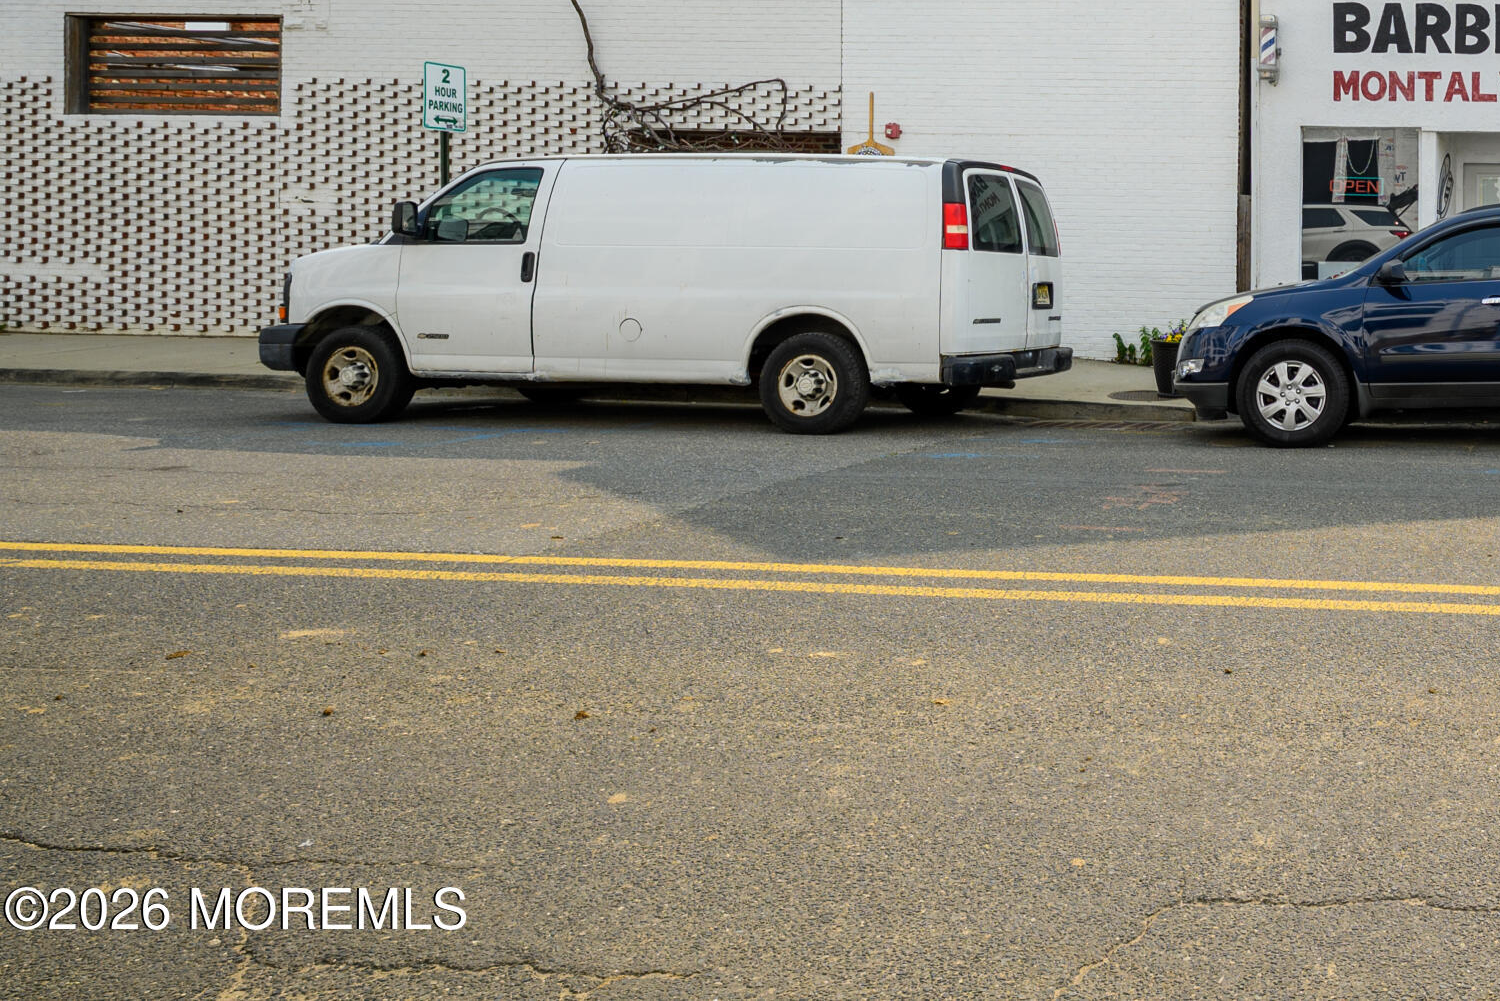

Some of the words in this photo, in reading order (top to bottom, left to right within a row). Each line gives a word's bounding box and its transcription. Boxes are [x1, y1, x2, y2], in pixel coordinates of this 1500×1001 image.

[442, 69, 450, 84] 2
[434, 86, 457, 99] HOUR
[428, 100, 463, 114] PARKING
[1329, 179, 1380, 193] OPEN
